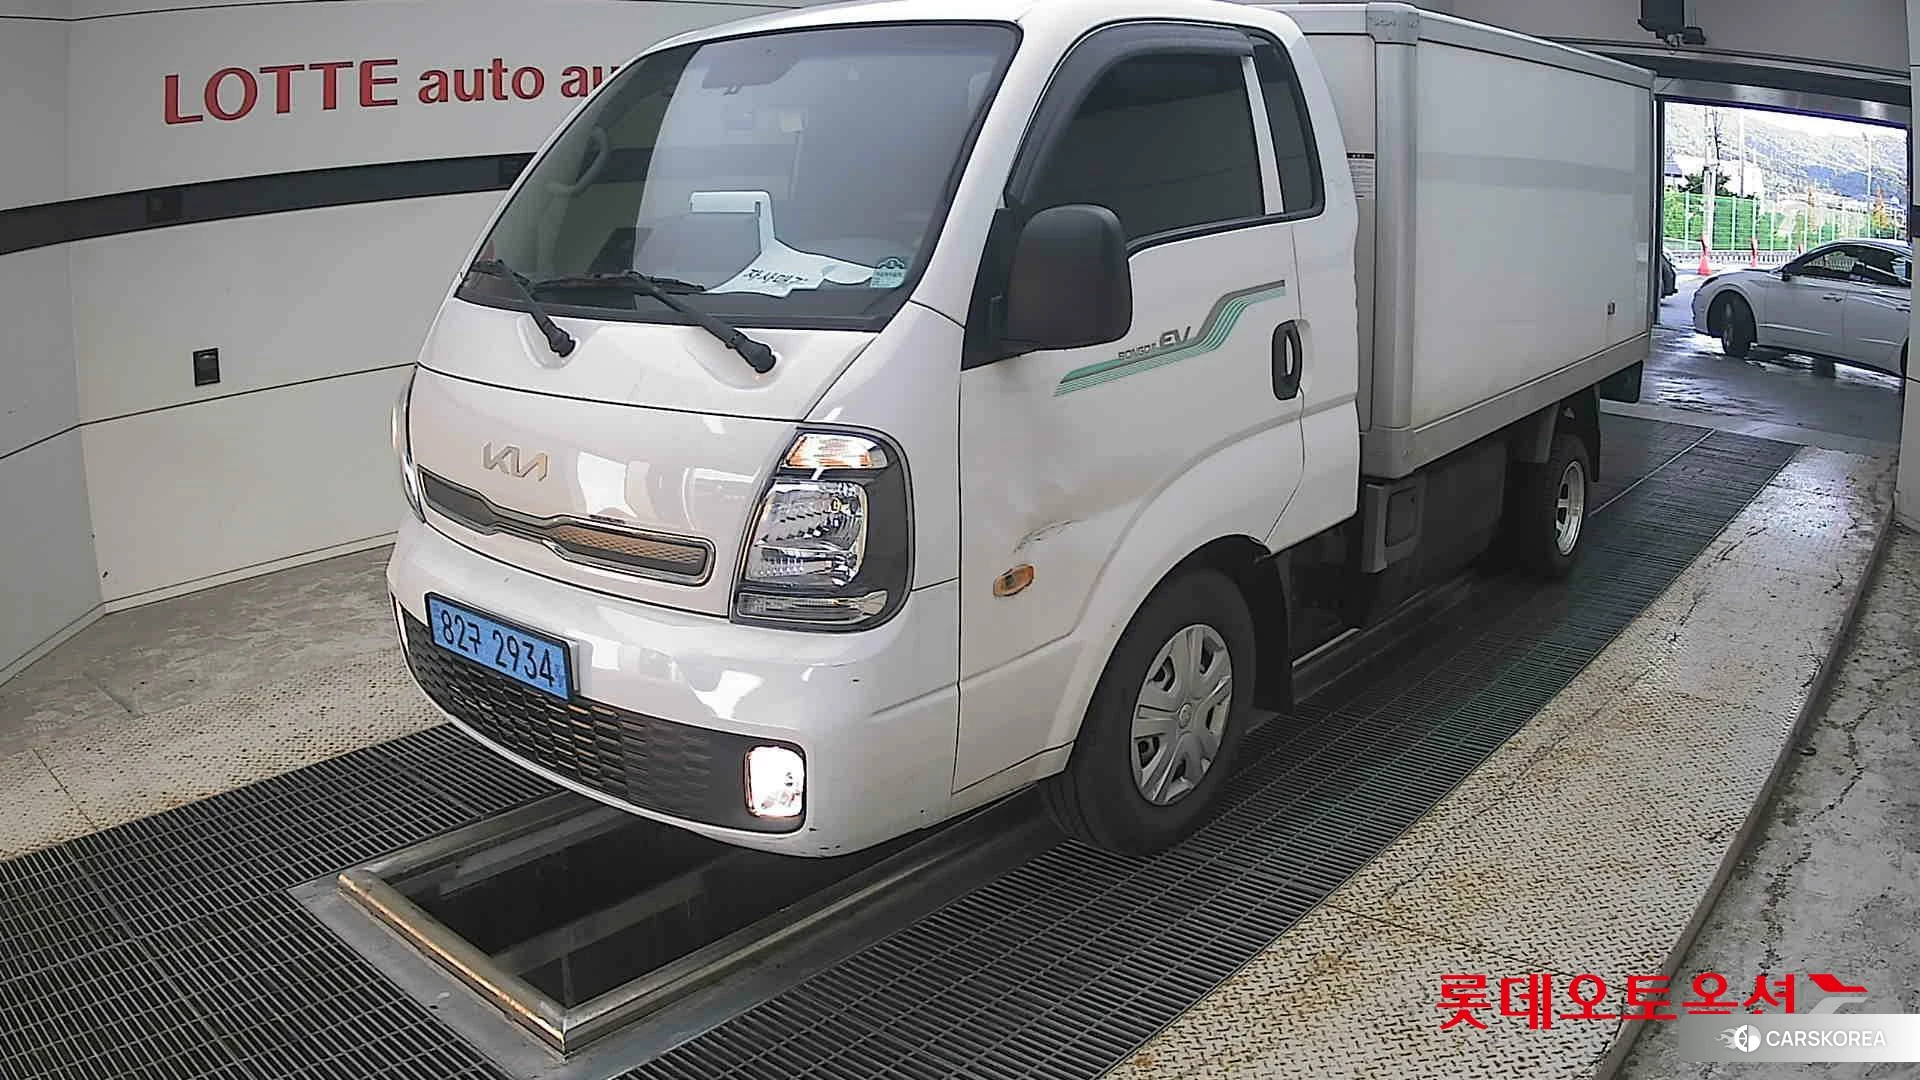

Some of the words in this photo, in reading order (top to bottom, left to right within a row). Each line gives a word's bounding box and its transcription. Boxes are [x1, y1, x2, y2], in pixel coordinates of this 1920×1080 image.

[164, 58, 399, 125] LOTTE
[418, 57, 545, 104] auto
[483, 441, 548, 482] KIA
[440, 609, 482, 655] 82구
[492, 629, 556, 688] 2934
